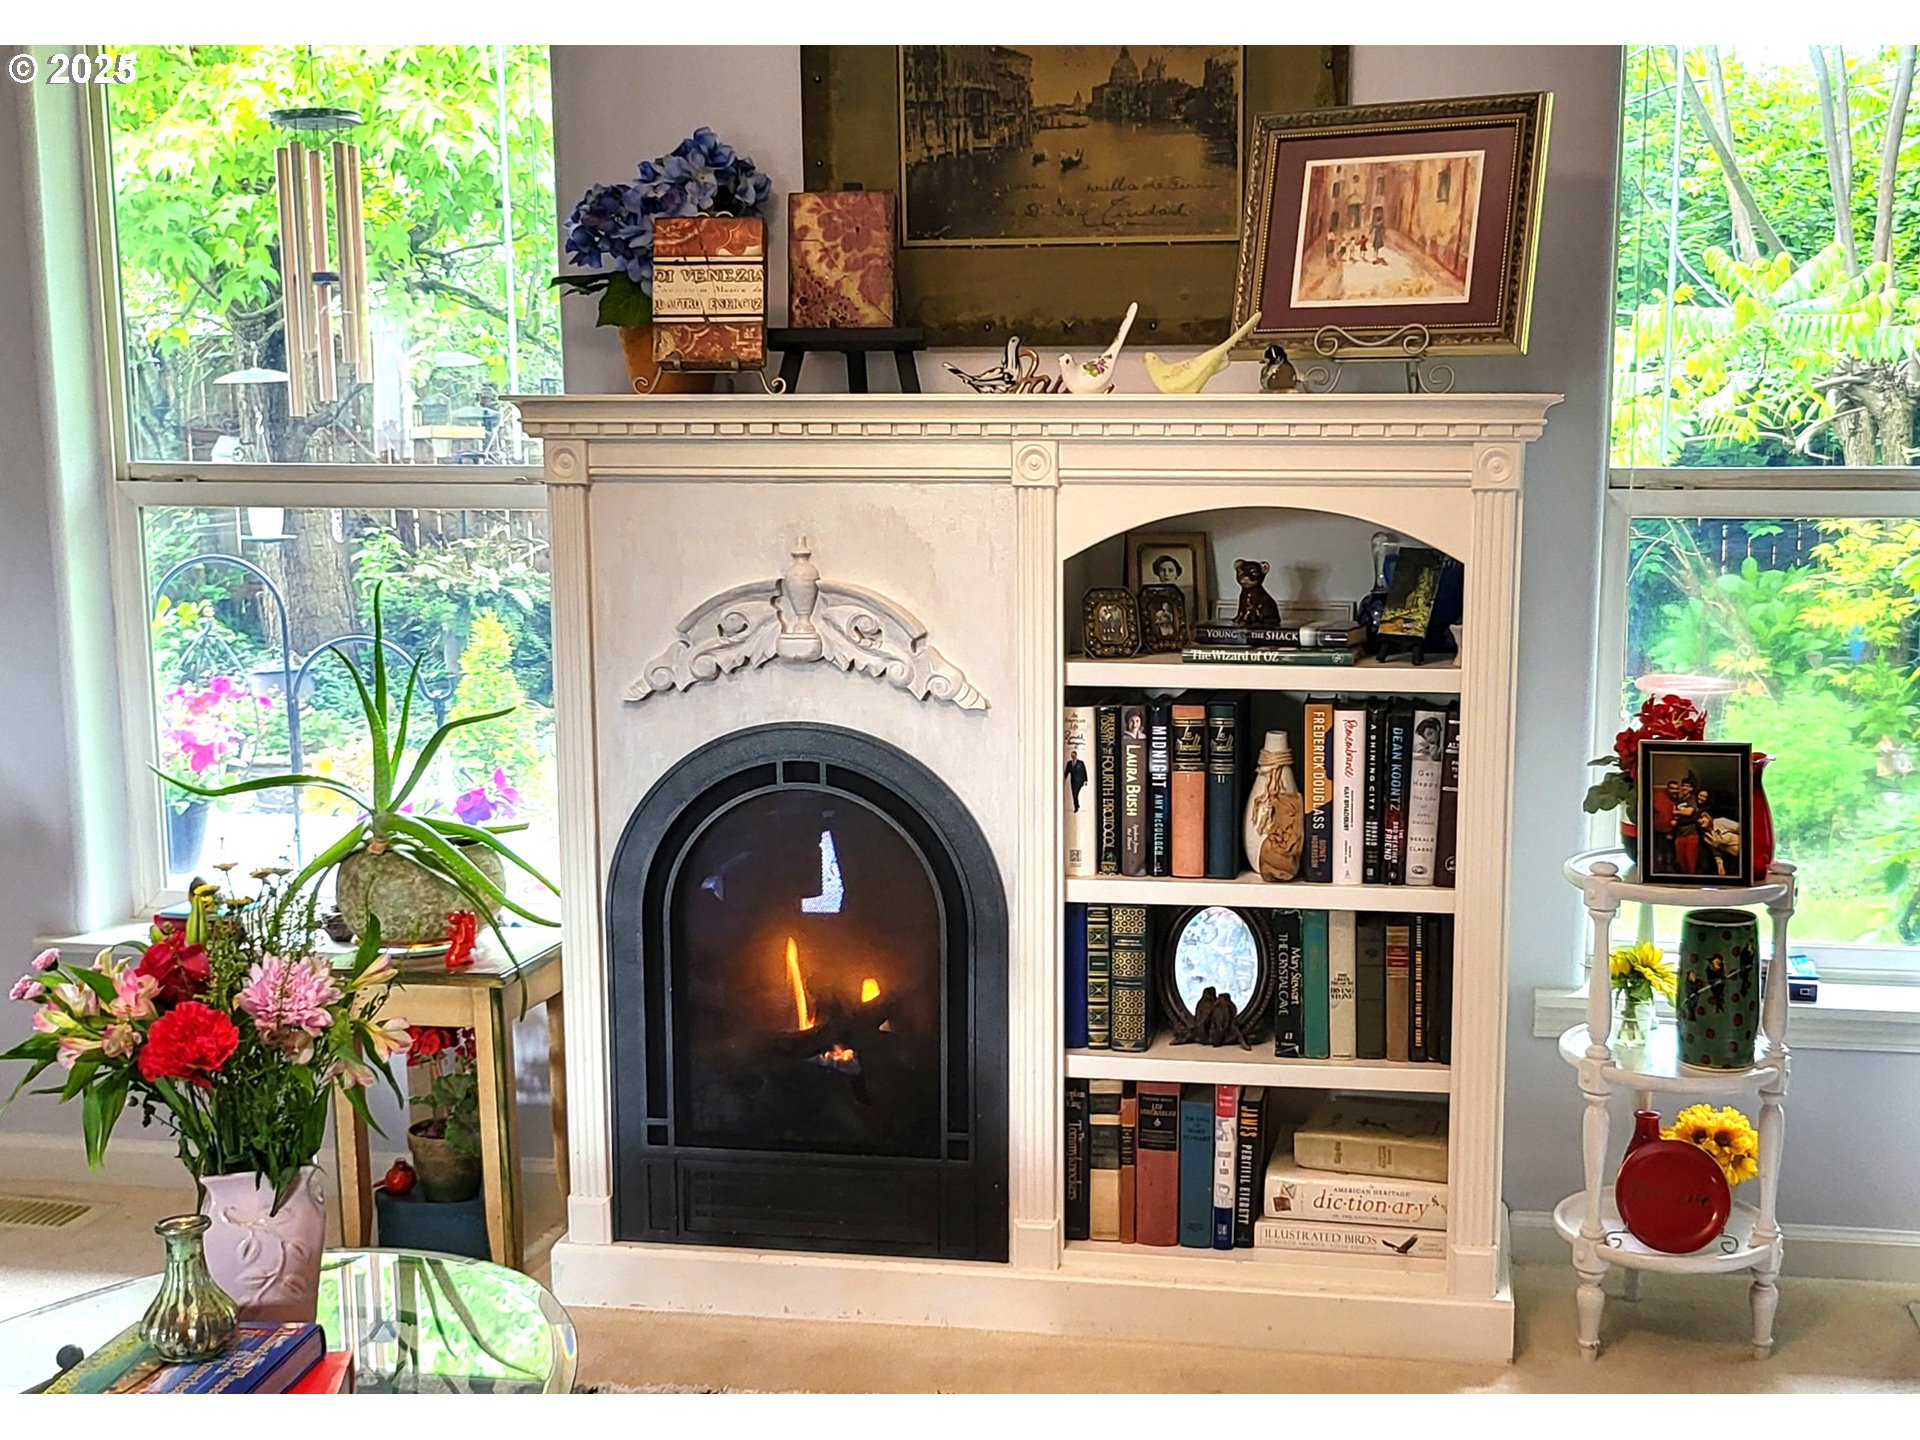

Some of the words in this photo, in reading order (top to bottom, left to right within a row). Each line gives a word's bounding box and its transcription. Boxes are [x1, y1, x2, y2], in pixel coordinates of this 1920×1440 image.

[682, 269, 764, 284] VENEZIA
[1206, 629, 1238, 639] YOUNG
[1251, 632, 1264, 640] THE
[1265, 631, 1299, 641] SHACK
[1191, 650, 1211, 661] The
[1211, 650, 1249, 662] Wizard
[1250, 651, 1261, 662] of
[1312, 711, 1325, 769] FREDERICK
[1391, 727, 1404, 760] DEAN
[1126, 745, 1141, 782] LAURA
[1151, 726, 1167, 788] MIDNIGHT
[1102, 755, 1115, 796] FOURTH
[1390, 763, 1403, 811] KOONTZ
[1125, 784, 1141, 816] BUSH
[1154, 794, 1164, 810] AMY
[1312, 772, 1325, 829] DOUGLASS
[1102, 798, 1115, 848] PROTOCOL
[1384, 828, 1392, 860] FRIEND
[1278, 932, 1289, 951] THE
[1278, 951, 1288, 990] CRYSTAL
[1289, 947, 1301, 971] Mary
[1278, 990, 1288, 1016] CAVE
[1290, 972, 1301, 1005] Stewart
[1239, 1106, 1259, 1138] JAMES
[1238, 1187, 1251, 1225] EVERETT
[1333, 1187, 1371, 1195] AMERICAN
[1264, 1228, 1341, 1243] ILLUSTRATED
[1344, 1231, 1378, 1245] BIRDS
